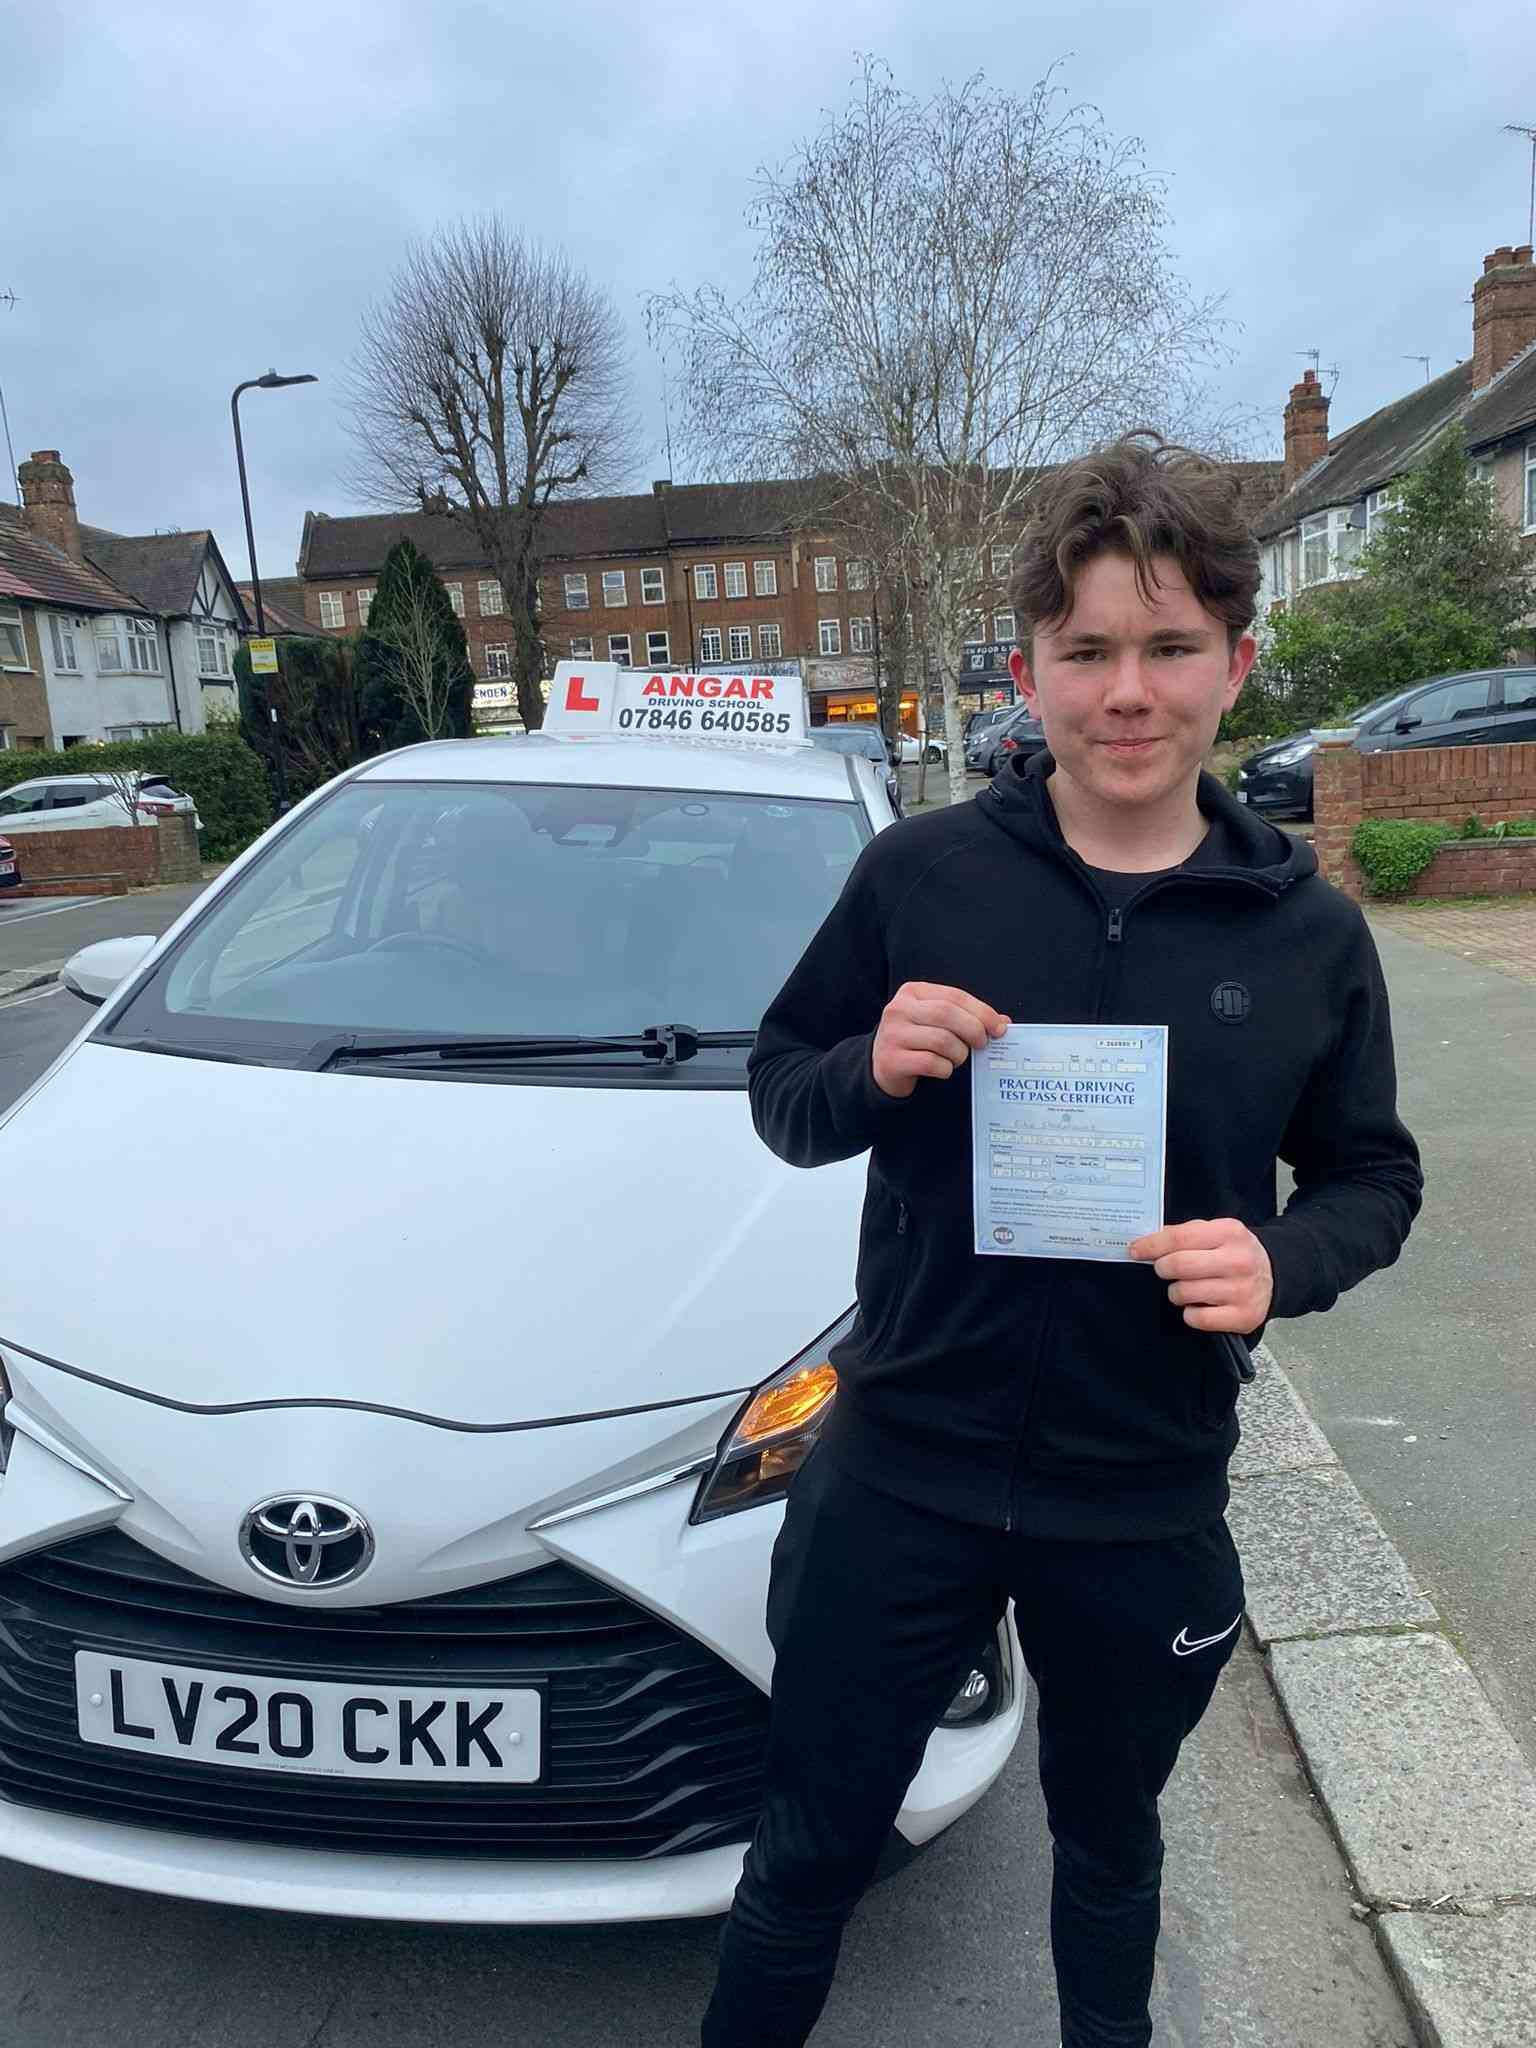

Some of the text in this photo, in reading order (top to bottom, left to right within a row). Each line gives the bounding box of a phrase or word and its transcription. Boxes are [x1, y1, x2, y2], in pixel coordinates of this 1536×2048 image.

[565, 677, 600, 711] L
[643, 676, 774, 699] ANGAR
[649, 698, 764, 710] DRIVING SCHOOL
[619, 708, 791, 733] 07846 640585
[999, 1078, 1135, 1093] PRACTICAL DRIVING
[1000, 1090, 1135, 1105] TEST PASS CERTIFICATE
[110, 1669, 504, 1768] LV20 CKK
